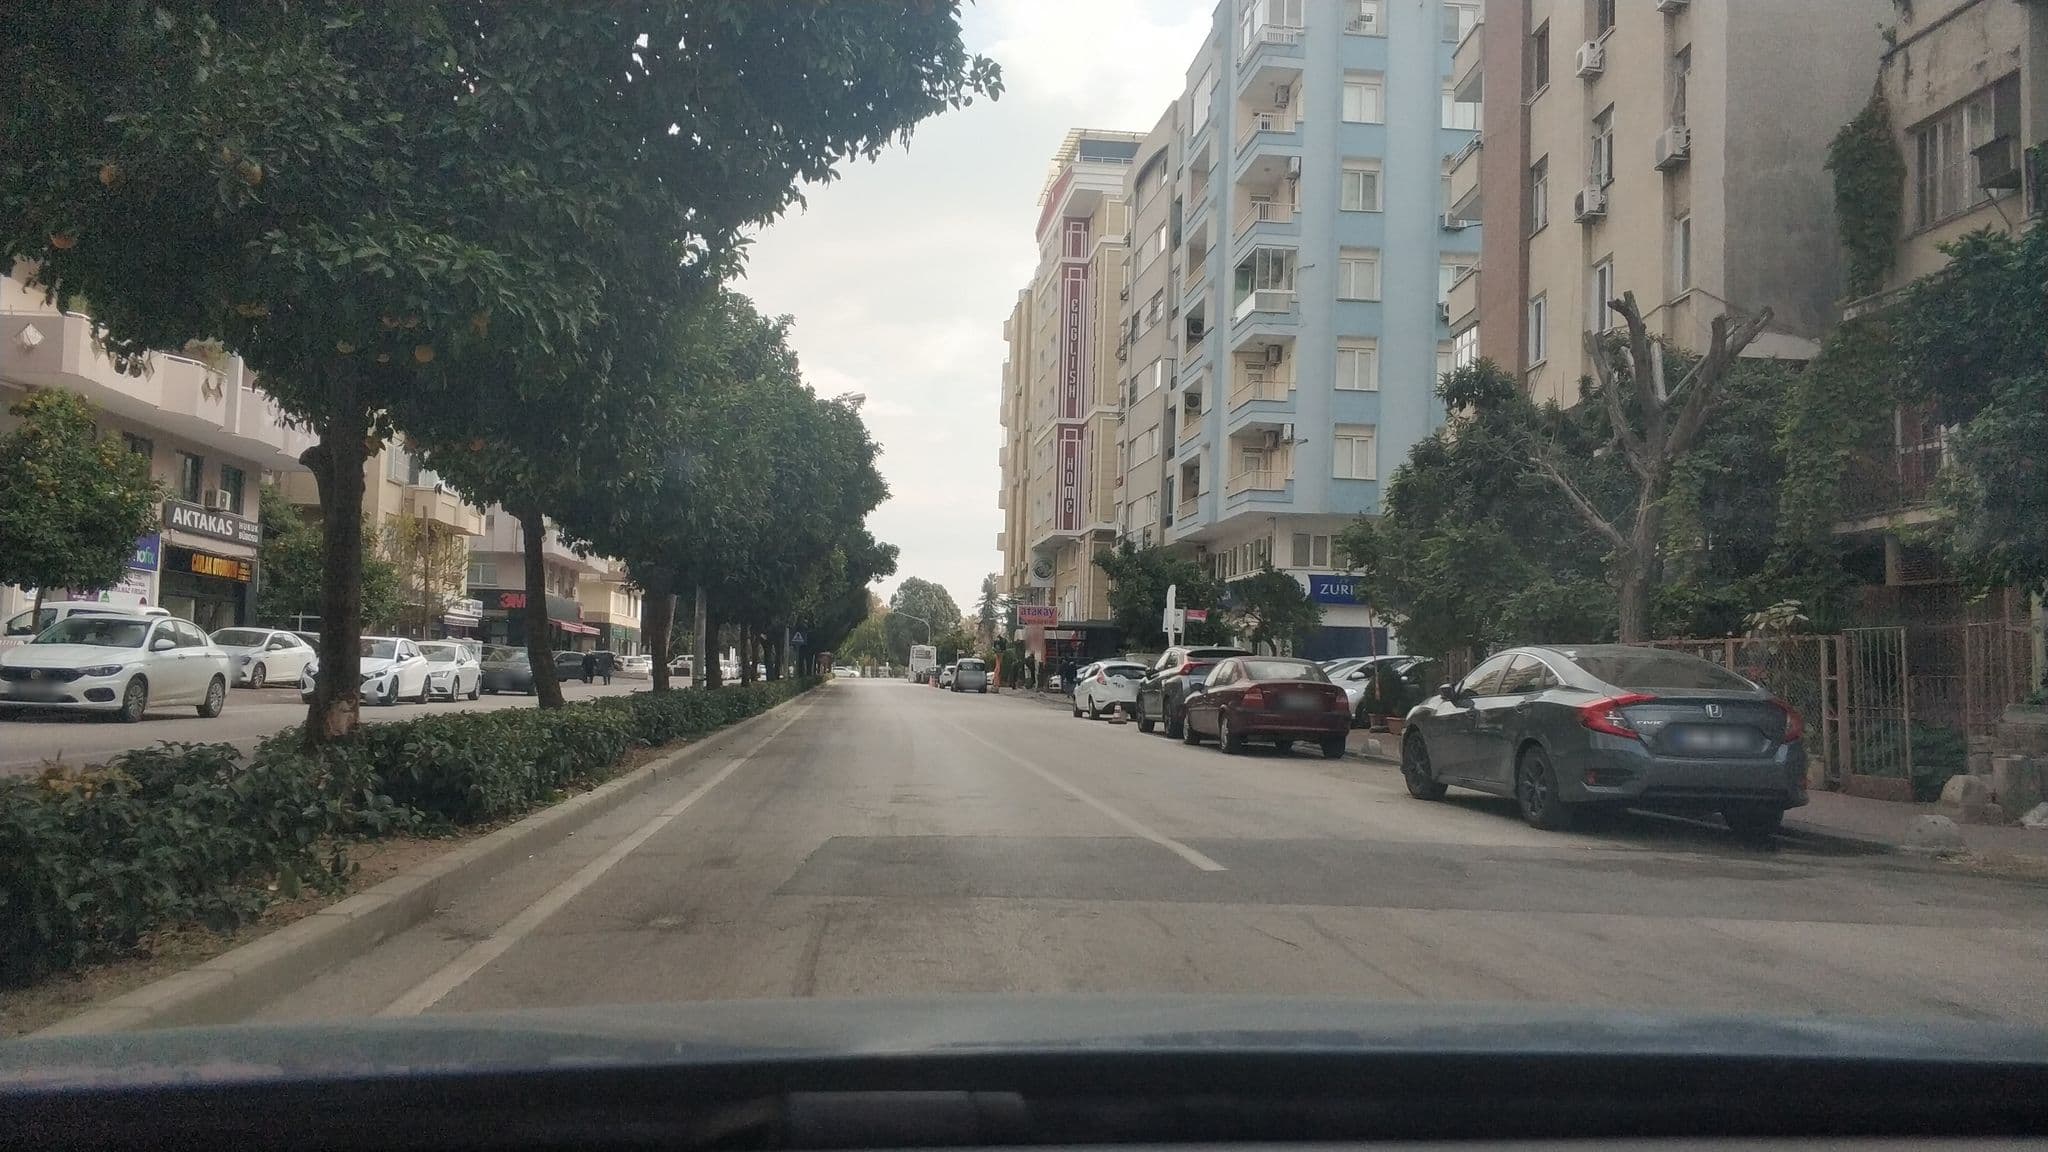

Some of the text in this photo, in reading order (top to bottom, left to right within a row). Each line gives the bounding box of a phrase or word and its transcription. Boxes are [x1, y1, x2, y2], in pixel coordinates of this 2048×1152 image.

[172, 507, 233, 536] AKTAKAS
[1320, 583, 1354, 596] ZURI
[500, 592, 526, 609] 3M
